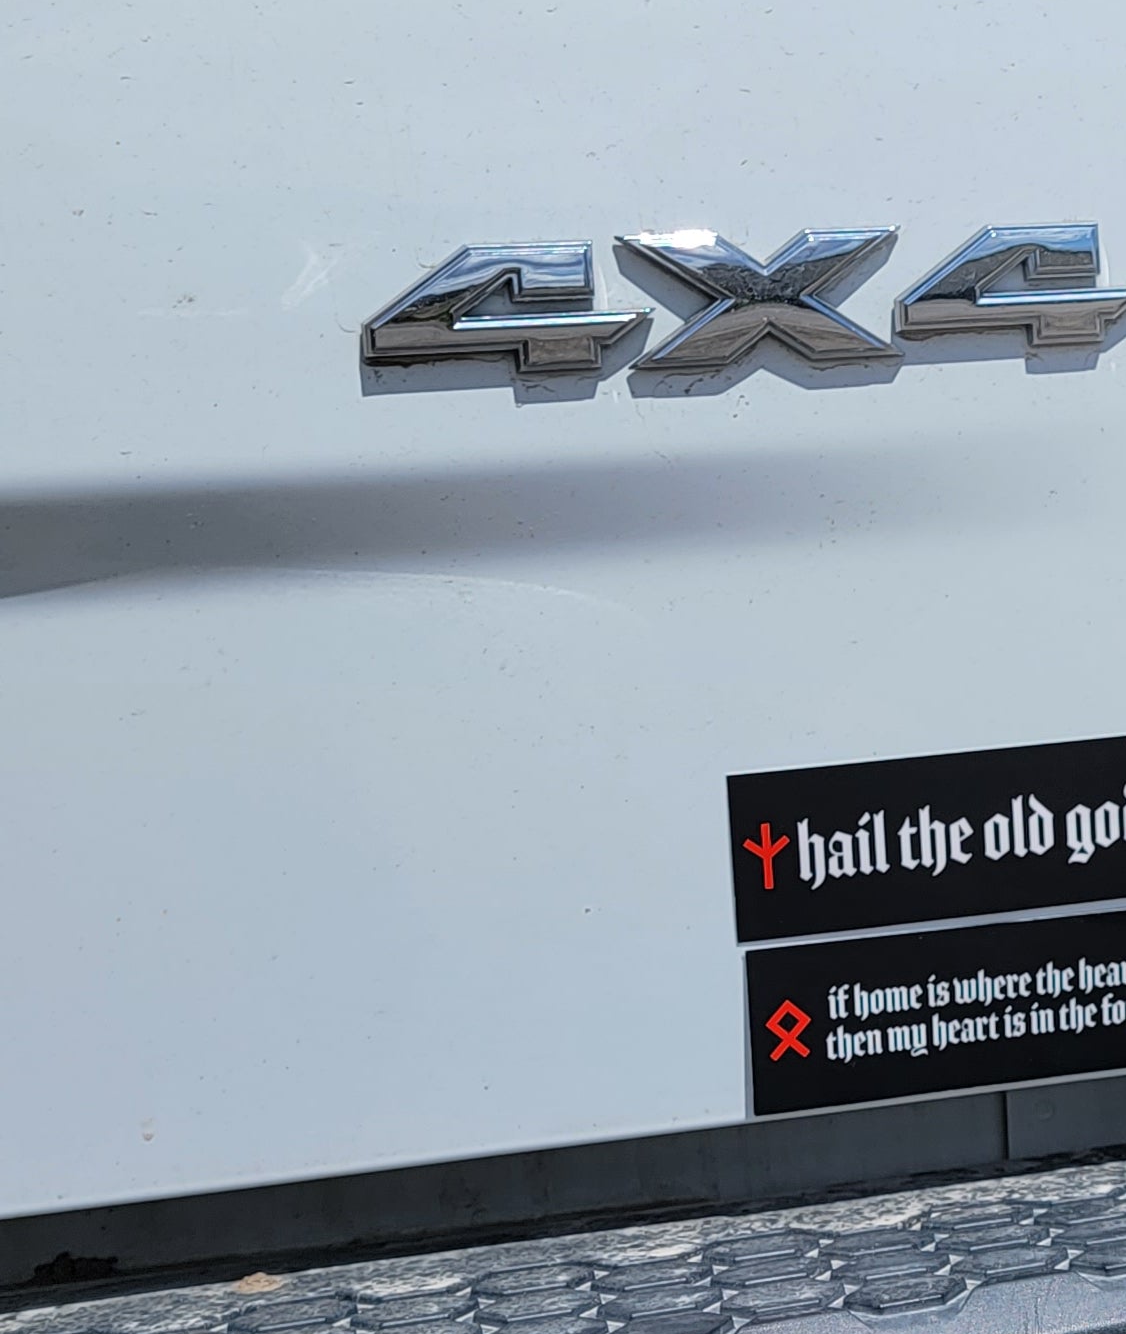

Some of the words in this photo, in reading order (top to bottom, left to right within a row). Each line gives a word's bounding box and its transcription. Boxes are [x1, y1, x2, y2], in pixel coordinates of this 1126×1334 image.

[797, 809, 891, 890] hail
[897, 805, 974, 877] the
[983, 793, 1055, 861] old
[827, 983, 850, 1020] if
[853, 982, 923, 1021] home
[926, 974, 950, 1008] is
[952, 969, 1032, 1006] where
[1035, 961, 1075, 998] the
[826, 1025, 883, 1063] then
[886, 1023, 929, 1057] my
[932, 1012, 1000, 1051] heart
[1003, 1005, 1026, 1038] is
[1029, 1002, 1055, 1035] in
[1058, 997, 1098, 1034] the
